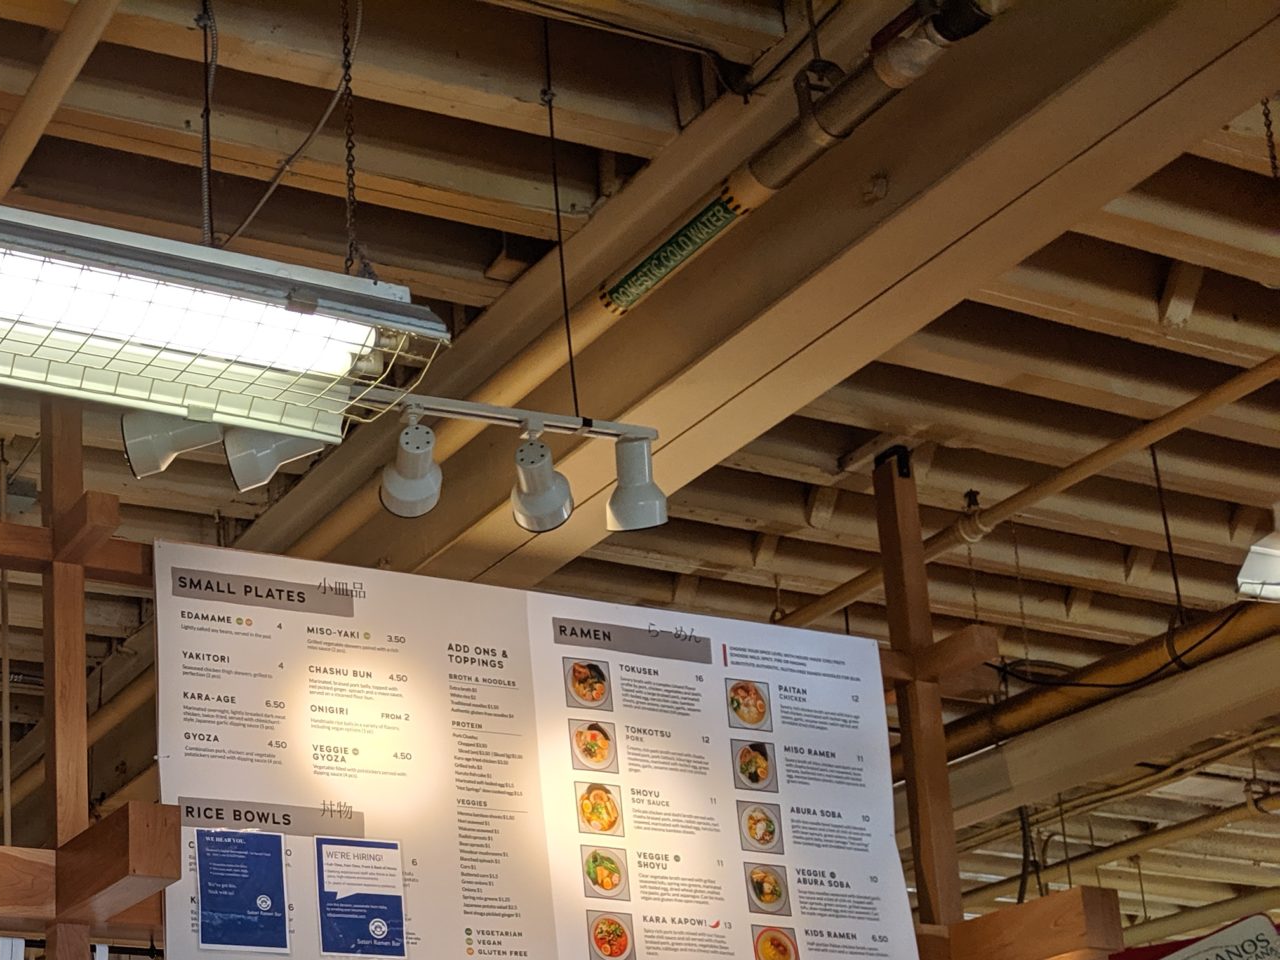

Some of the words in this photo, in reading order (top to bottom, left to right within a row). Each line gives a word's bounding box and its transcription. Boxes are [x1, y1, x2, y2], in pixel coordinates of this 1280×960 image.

[688, 206, 732, 245] WATER
[178, 576, 236, 595] SMALL
[243, 584, 306, 603] PLATES
[180, 610, 232, 624] EDAMAME
[276, 622, 283, 630] 4
[307, 626, 360, 640] MISO-YAKI
[559, 624, 612, 642] RAMEN
[647, 622, 702, 644] らーめん
[386, 635, 406, 644] 3.50
[448, 642, 470, 653] ADD
[474, 646, 497, 657] ONS
[501, 649, 508, 658] &
[182, 650, 230, 663] YAKITORI
[448, 654, 504, 669] TOPPINGS
[308, 665, 348, 676] CHASHU
[352, 669, 372, 679] BUN
[618, 663, 660, 676] TOKUSEN
[388, 674, 408, 683] 4.50
[448, 673, 472, 682] BROTH
[482, 677, 516, 687] NOODLES
[695, 674, 704, 682] 16
[778, 684, 808, 696] PAITAN
[183, 691, 237, 704] KARA-AGE
[779, 694, 807, 703] CHICKEN
[264, 700, 286, 709] 6.50
[310, 704, 349, 715] ONIGIRI
[381, 712, 402, 721] FROM
[404, 713, 410, 721] 2
[451, 720, 483, 729] PROTEIN
[184, 731, 220, 742] GYOZA
[625, 725, 671, 739] TONKOTSU
[625, 734, 644, 743] PORK
[701, 736, 710, 744] 12
[267, 740, 287, 749] 4.50
[312, 743, 349, 755] VEGGIE
[392, 752, 412, 760] 4.50
[783, 745, 805, 755] MISO
[807, 748, 836, 758] RAMEN
[312, 753, 347, 763] GYOZA
[630, 788, 660, 798] SHOYU
[456, 799, 488, 807] VEGGIES
[631, 797, 645, 805] SOY
[647, 799, 670, 807] SAUCE
[185, 806, 225, 820] RICE
[233, 809, 292, 825] BOWLS
[790, 806, 817, 816] ABURA
[820, 809, 842, 819] SOBA
[861, 815, 870, 823] 10
[326, 850, 351, 860] WE'RE
[352, 852, 384, 862] HIRING!
[636, 851, 670, 862] VEGGIE
[637, 861, 668, 870] SHOYU
[795, 868, 826, 878] VEGGIE
[797, 878, 825, 887] ABURA
[827, 880, 851, 889] SOBA
[642, 915, 668, 924] KARA
[671, 917, 707, 927] KAPOW!
[476, 929, 523, 937] VEGETARIAN
[804, 928, 824, 938] KIDS
[827, 930, 857, 940] RAMEN
[871, 934, 888, 943] 6.50
[477, 948, 507, 956] GLUTEN
